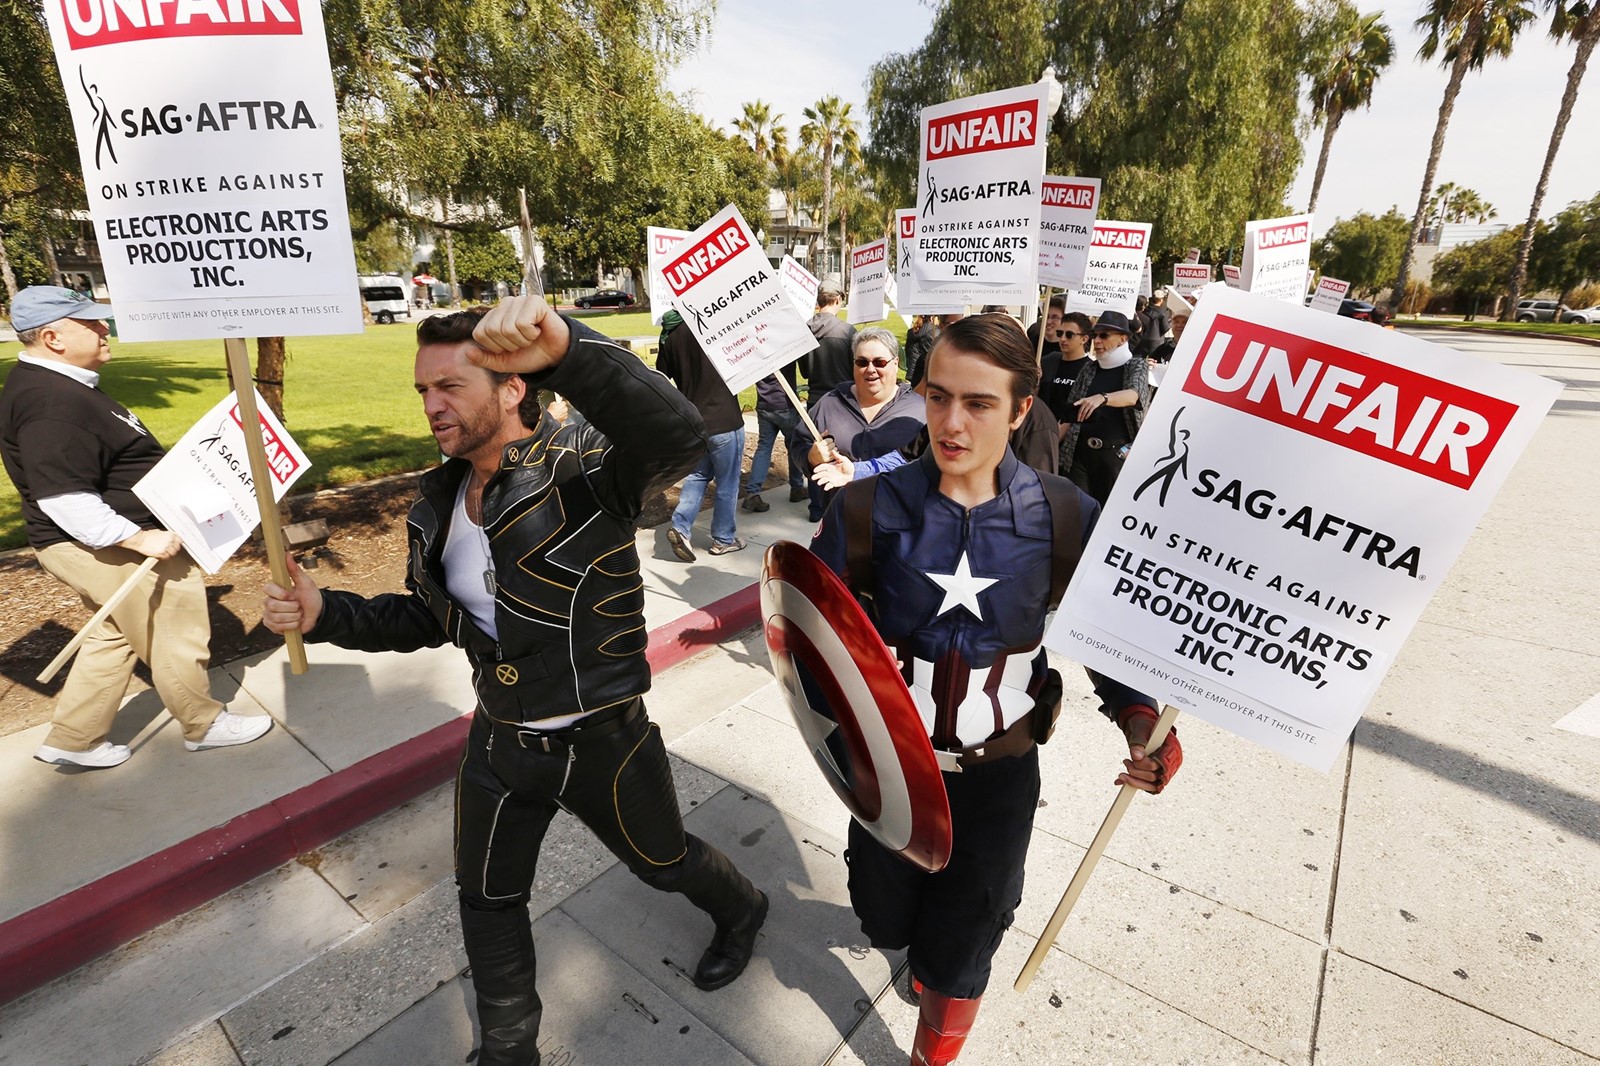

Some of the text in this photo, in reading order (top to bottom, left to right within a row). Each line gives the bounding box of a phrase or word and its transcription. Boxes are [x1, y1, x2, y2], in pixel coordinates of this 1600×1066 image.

[929, 110, 1033, 154] UNFAIR
[102, 172, 324, 200] ON STRIKE AGAINST
[105, 209, 329, 240] ELECTRONIC ARTS
[921, 224, 935, 234] ON
[938, 221, 973, 232] STRIKE
[977, 218, 1030, 230] AGAINST
[1259, 226, 1307, 247] UNFAIR
[126, 237, 312, 265] PRODUCTIONS,
[919, 237, 1028, 250] ELECTRONIC ARTS
[1058, 243, 1085, 251] AGAINST
[666, 226, 747, 290] UNFAIR
[854, 249, 884, 267] UNFAIR
[926, 251, 1015, 265] PRODUCTIONS,
[953, 265, 979, 276] INC.
[190, 265, 244, 288] INC.
[1176, 269, 1207, 278] UNFAIR
[1321, 280, 1345, 292] UNFAIR
[1082, 283, 1116, 292] ECTRONIC
[129, 304, 344, 322] NO DISPUTE WITH ANY OTHER EMPLOYER AT THIS SITE.
[1094, 297, 1109, 305] INC.
[705, 335, 717, 345] ON
[718, 317, 745, 338] STRIKE
[746, 293, 781, 320] AGAINST
[1200, 331, 1490, 477] UNFAIR
[234, 404, 295, 482] FAIR
[190, 449, 202, 463] ON
[218, 445, 257, 498] SAG·AF
[1121, 515, 1391, 631] ON STRIKE AGAINST
[1103, 544, 1373, 671] ELECTRONIC ARTS
[1112, 577, 1329, 690] PRODUCTIONS,
[1174, 634, 1235, 677] INC.
[1069, 629, 1084, 641] NO
[1086, 637, 1123, 659] DISPUTE
[1124, 654, 1149, 671] WITH
[1149, 666, 1170, 682] ANY
[1171, 677, 1203, 696] OTHER
[1204, 691, 1255, 719] EMPLOYER
[1256, 713, 1270, 725] AT
[1271, 719, 1294, 735] THIS
[1294, 728, 1318, 745] SITE.
